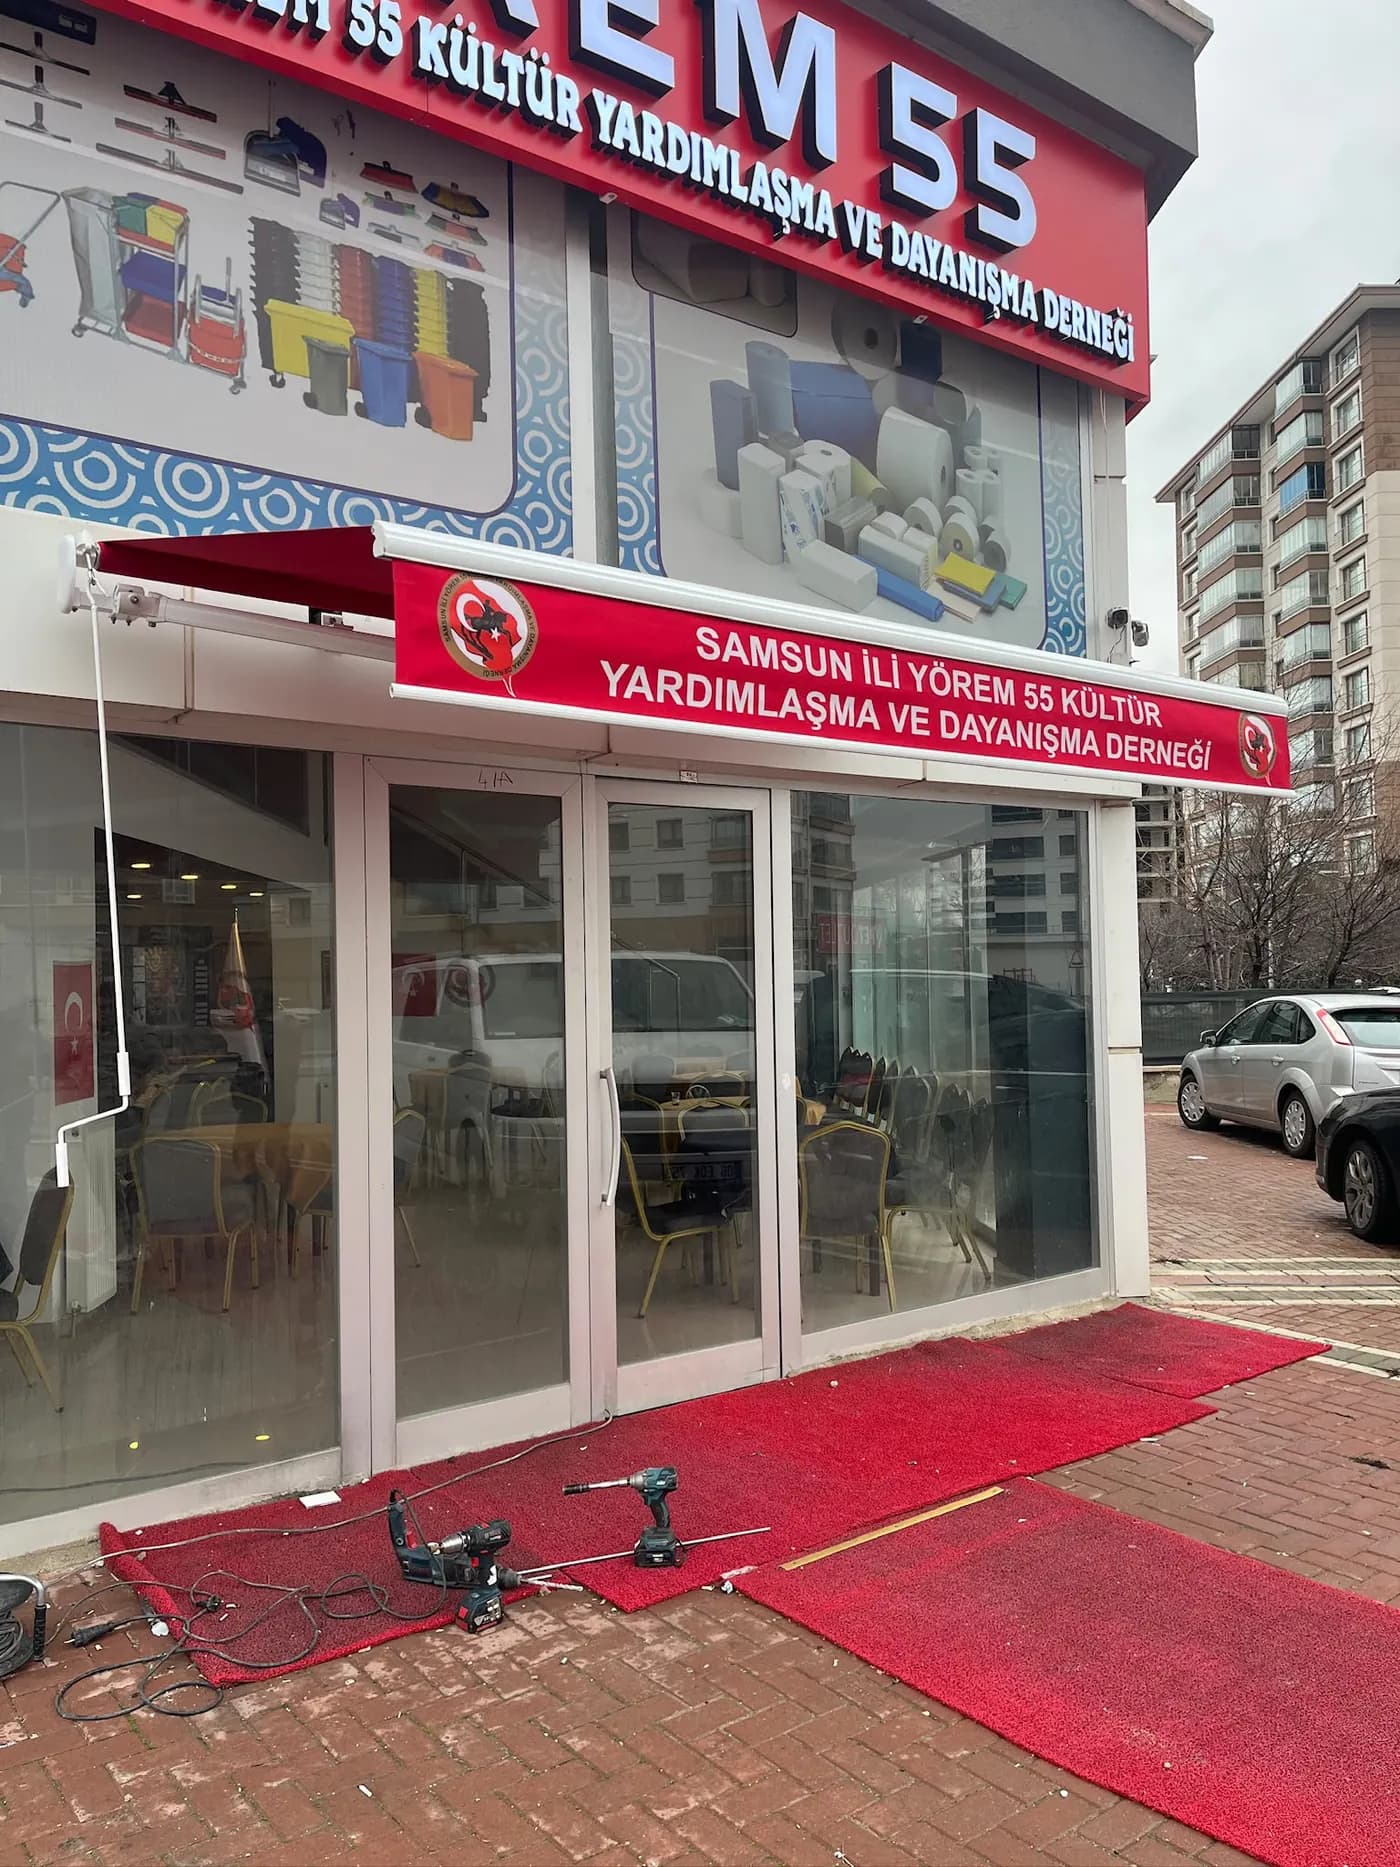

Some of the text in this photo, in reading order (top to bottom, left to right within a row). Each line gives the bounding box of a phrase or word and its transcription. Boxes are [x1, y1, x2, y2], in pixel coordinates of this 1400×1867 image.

[348, 0, 1136, 363] 55 KÜLTÜR YARDIMLAŞMA VE DAYANIŞMA DERNEĞİ
[890, 61, 1038, 249] 55
[600, 660, 881, 732] YARDIMLAŞMA
[887, 705, 931, 737] VE
[939, 710, 1101, 759] DAYANIŞMA
[1105, 738, 1212, 771] DERNEĞİ
[695, 626, 1164, 729] SAMSUN İLİ YÖREM 55 KÜLTÜR
